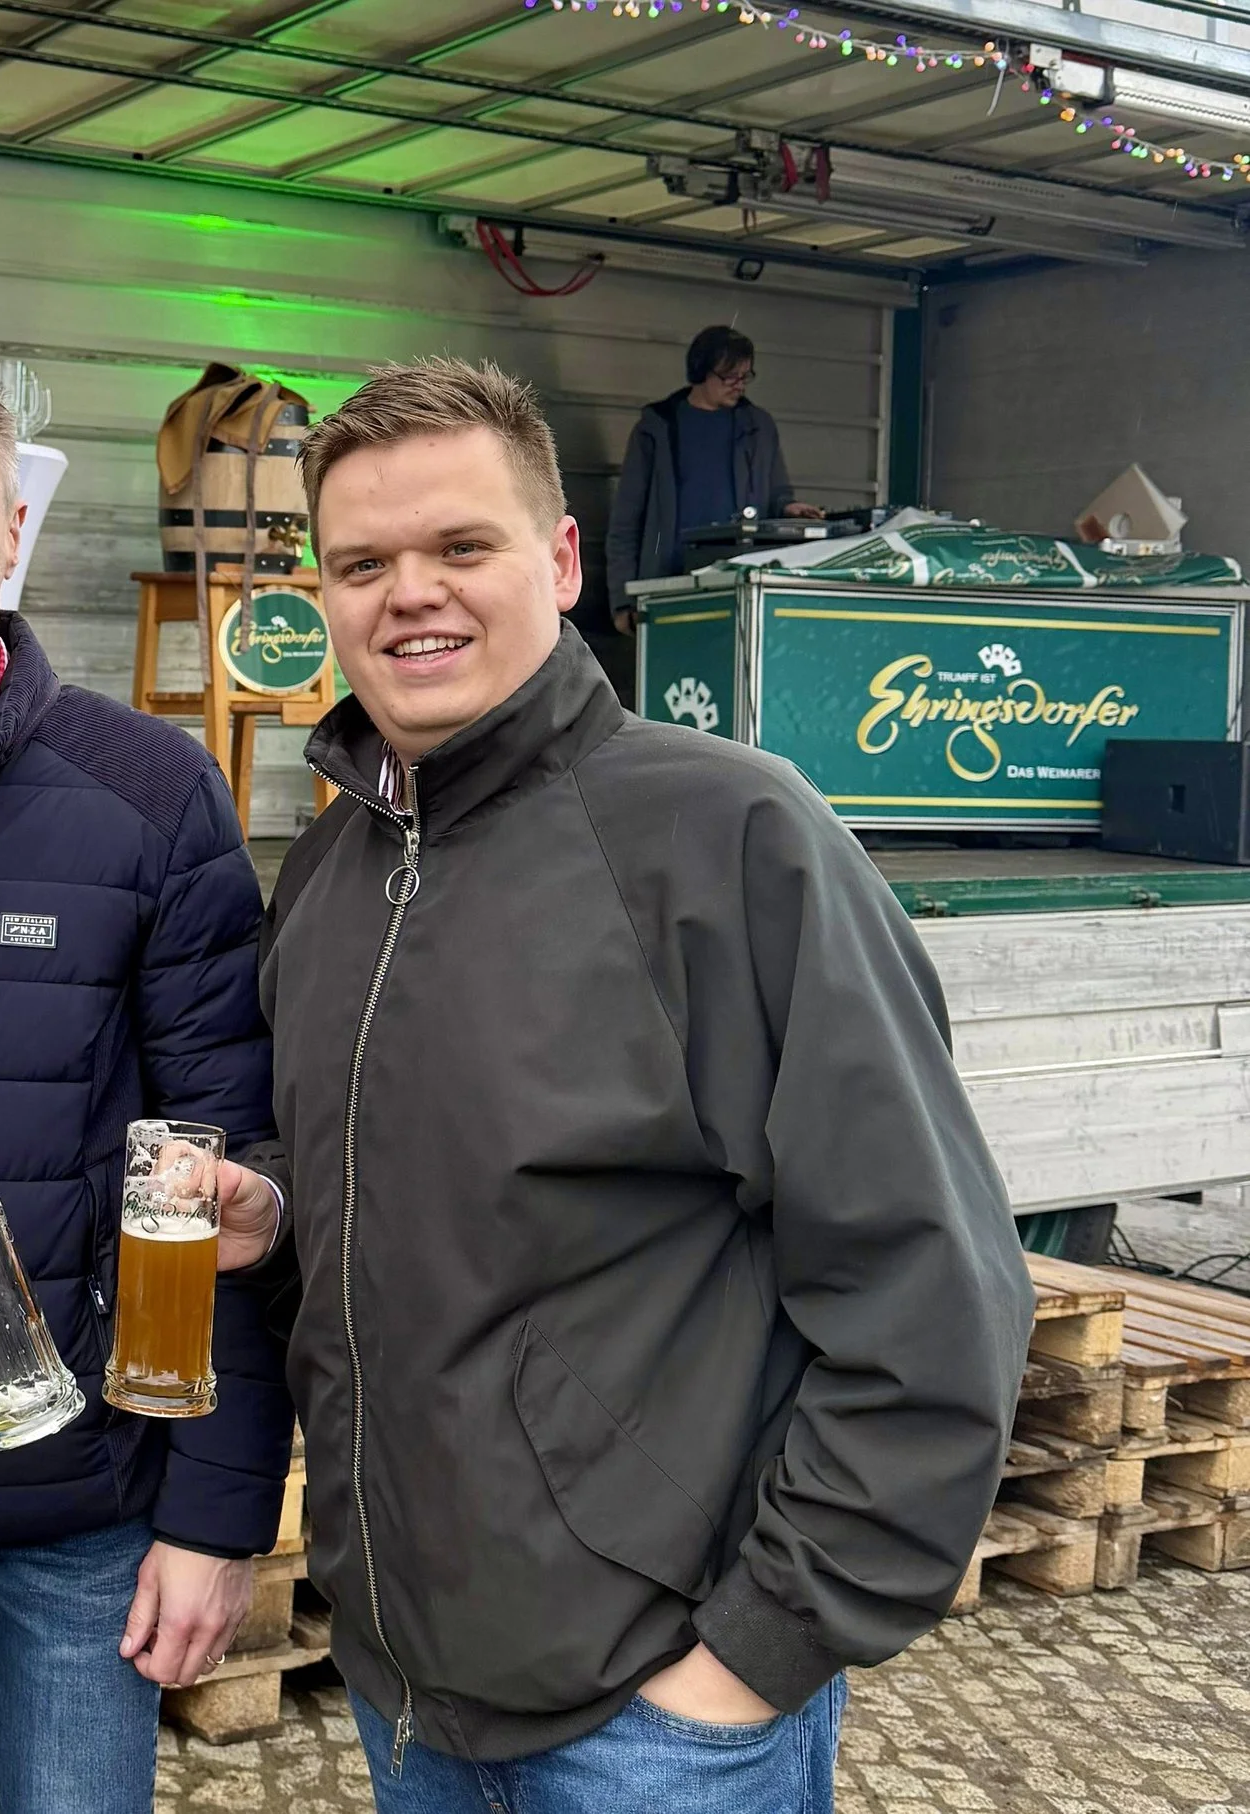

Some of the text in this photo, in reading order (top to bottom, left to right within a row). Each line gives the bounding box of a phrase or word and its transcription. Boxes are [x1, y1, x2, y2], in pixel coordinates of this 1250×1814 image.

[937, 671, 997, 684] TRUMPF IST
[857, 653, 1140, 782] Ehringsdorfer
